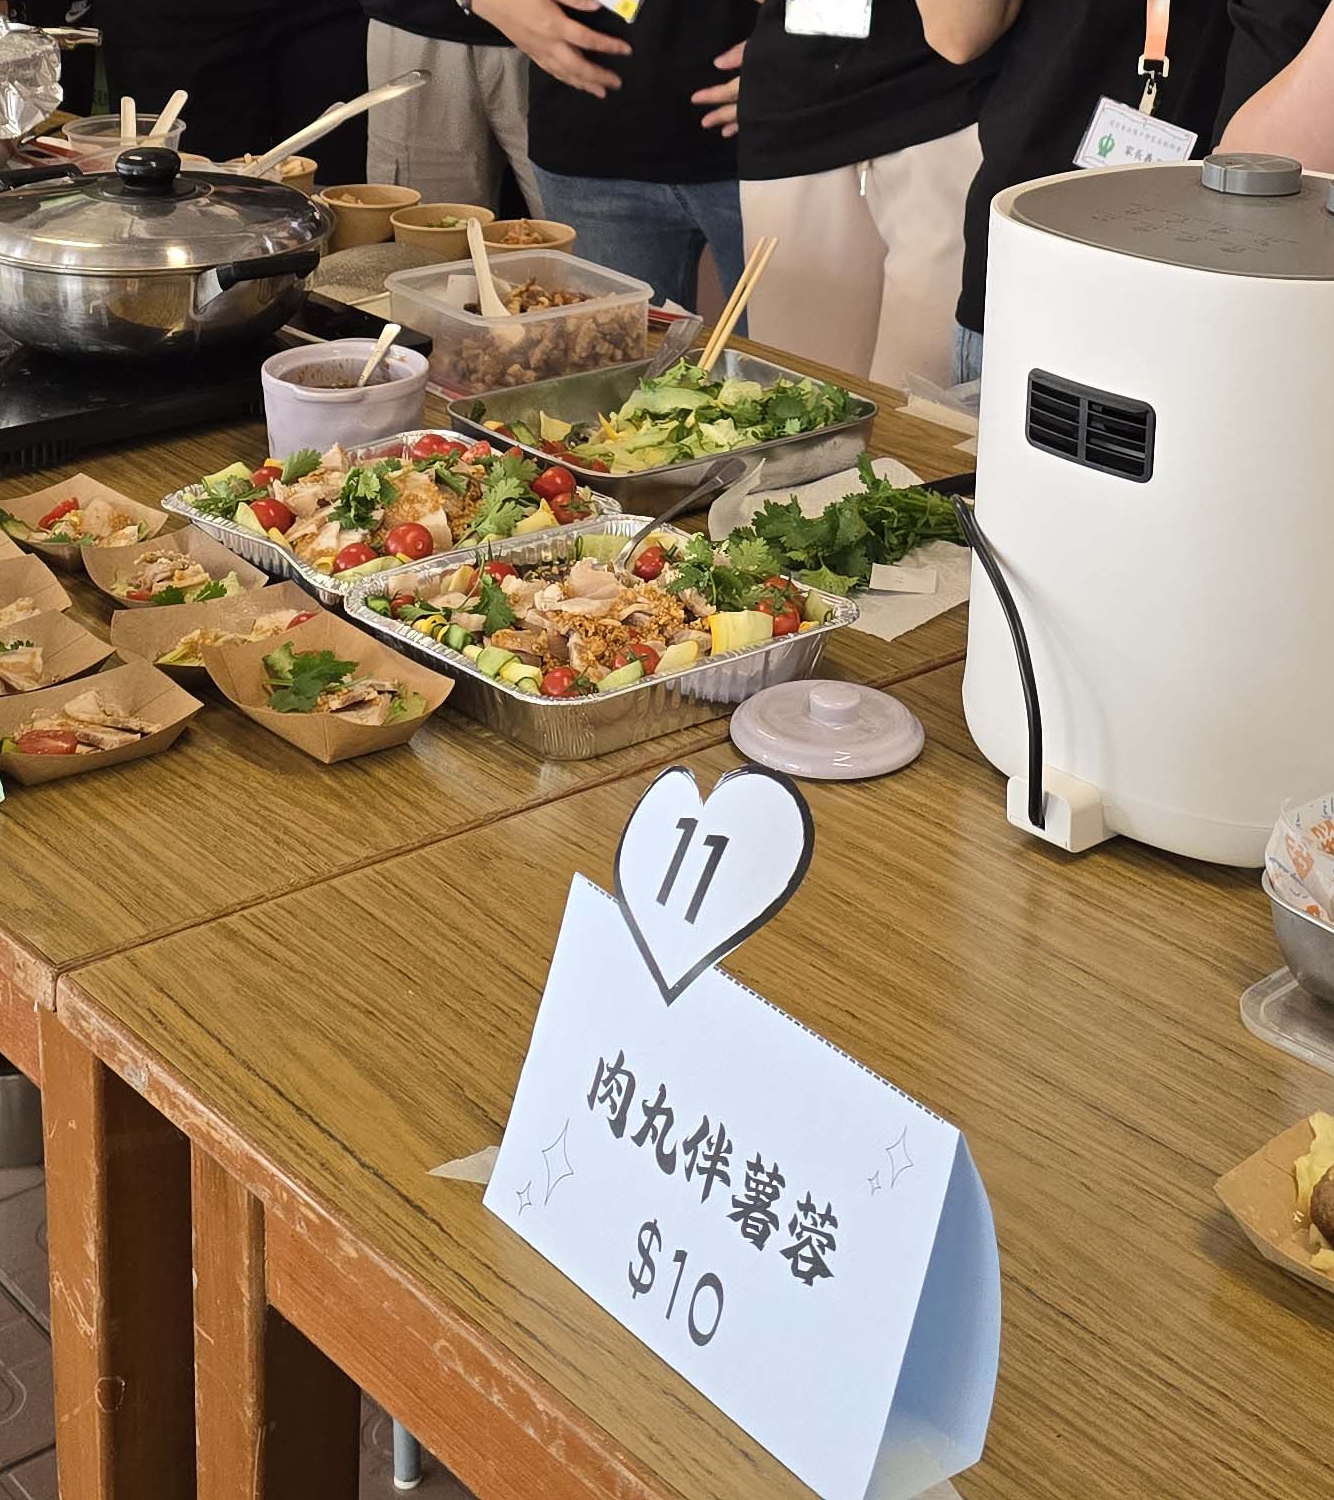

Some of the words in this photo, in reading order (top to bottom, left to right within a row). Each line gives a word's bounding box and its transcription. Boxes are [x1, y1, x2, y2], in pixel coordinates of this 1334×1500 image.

[654, 816, 730, 925] 11
[586, 1049, 845, 1287] 肉丸伴薯蓉
[626, 1217, 727, 1348] $10
